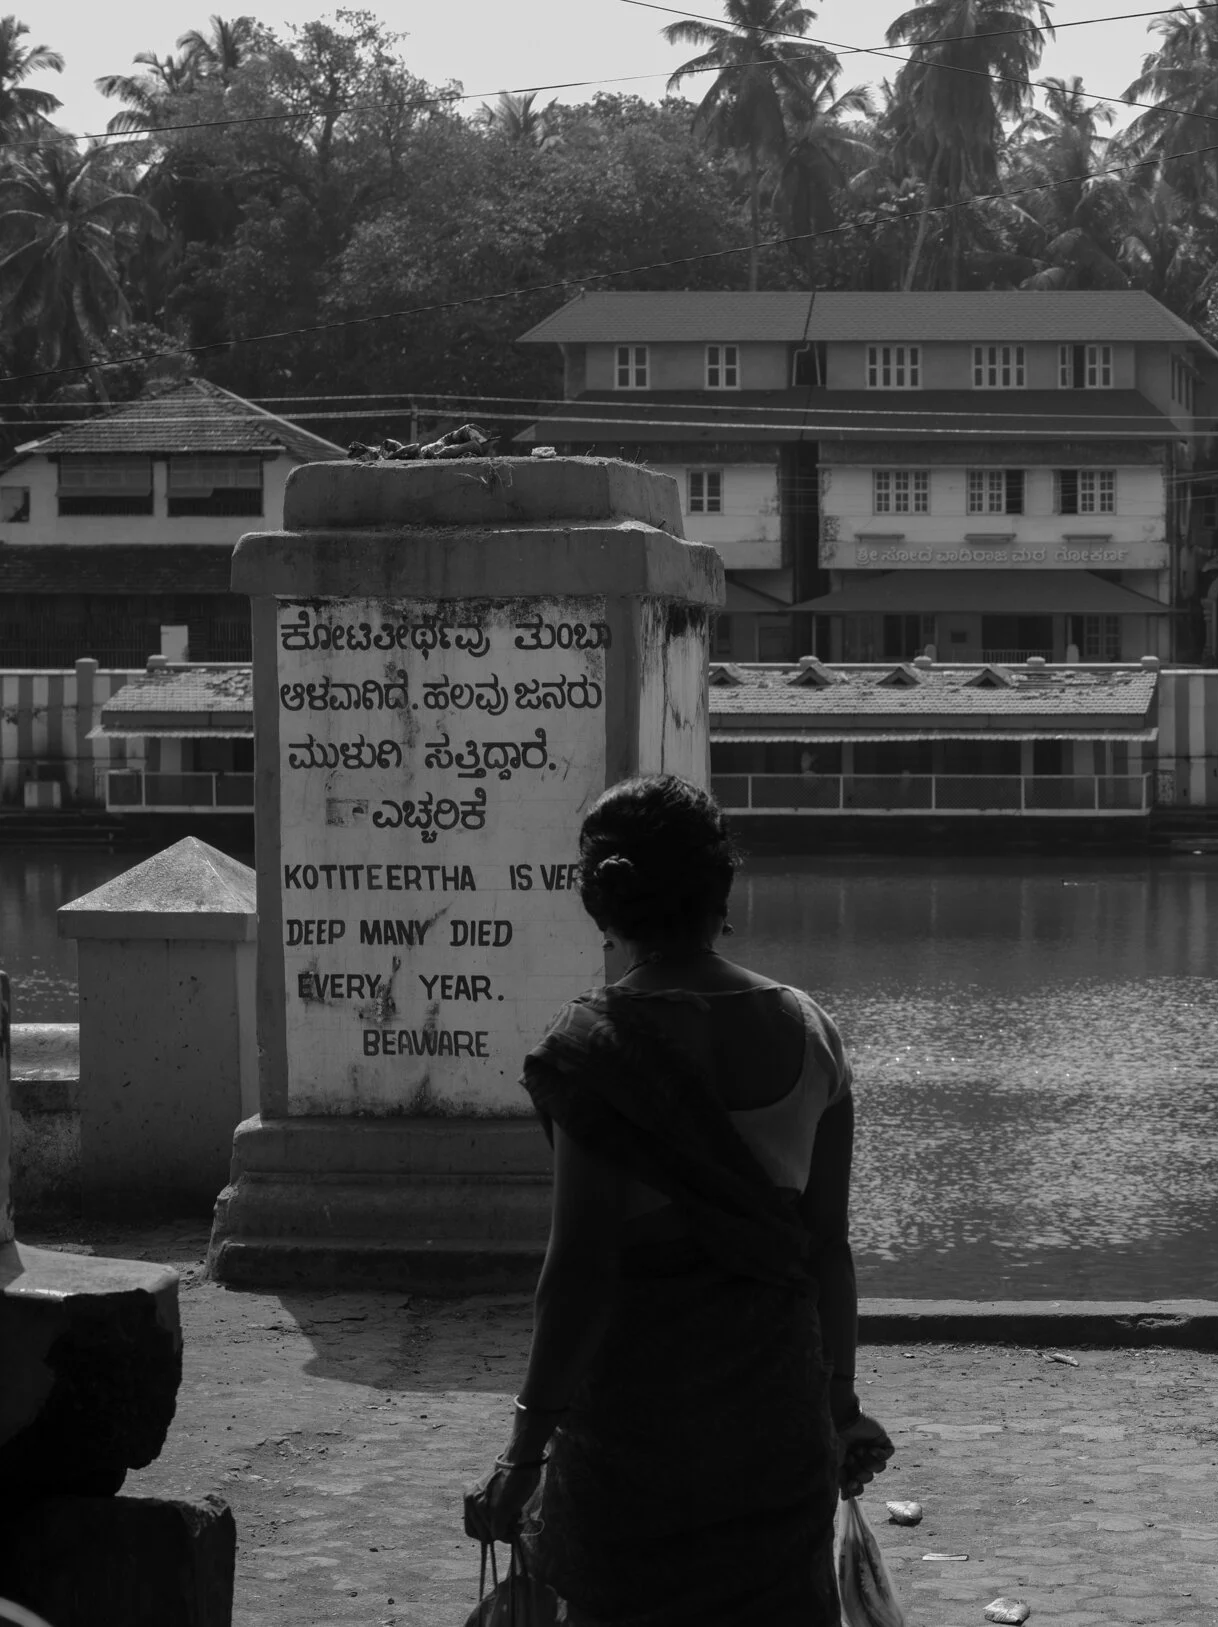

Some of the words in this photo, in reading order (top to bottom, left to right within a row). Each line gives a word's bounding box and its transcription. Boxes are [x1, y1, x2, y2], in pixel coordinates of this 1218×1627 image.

[856, 547, 878, 564] ಶ್ರೀ
[936, 548, 1008, 562] ವಾದಿರಾಜ
[1054, 547, 1128, 562] ಗೋಕರ್ಣ
[514, 613, 612, 651] ತುಂಬಾ
[422, 673, 509, 716] ಹಲವು
[512, 673, 604, 710] ಜನರು
[288, 734, 402, 770] ಮುಳುಗಿ
[371, 786, 487, 844] ಎಚ್ಚರಿಕೆ
[284, 864, 477, 891] KOTITEERTHA
[509, 864, 534, 891] IS
[286, 919, 346, 946] DEEP
[360, 920, 430, 946] MANY
[449, 920, 512, 947] DIED
[298, 972, 381, 999] EVERY
[419, 974, 504, 1002] YEAR.
[362, 1029, 490, 1058] BEAWARE
